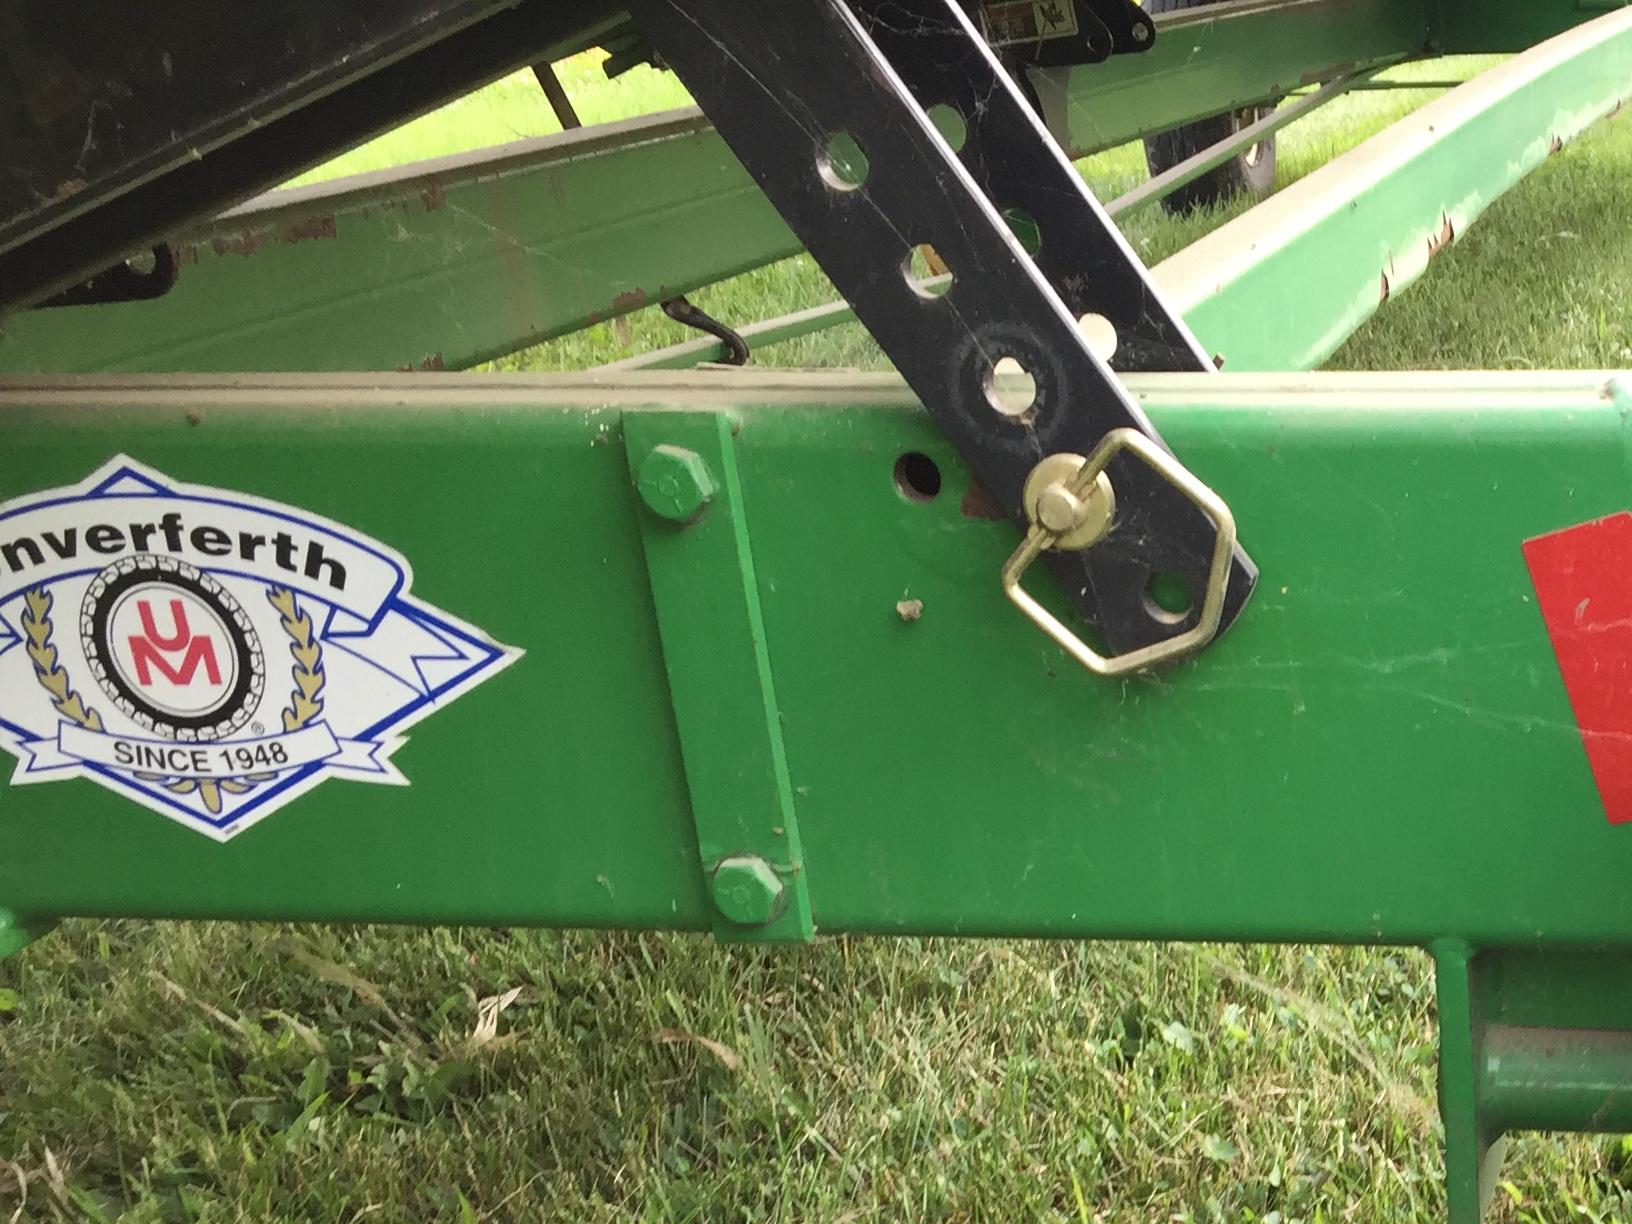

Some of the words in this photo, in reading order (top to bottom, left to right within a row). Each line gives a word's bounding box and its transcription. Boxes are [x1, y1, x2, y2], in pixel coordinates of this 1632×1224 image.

[0, 513, 347, 590] nverferth
[114, 741, 212, 773] SINCE
[219, 742, 289, 771] 1948
